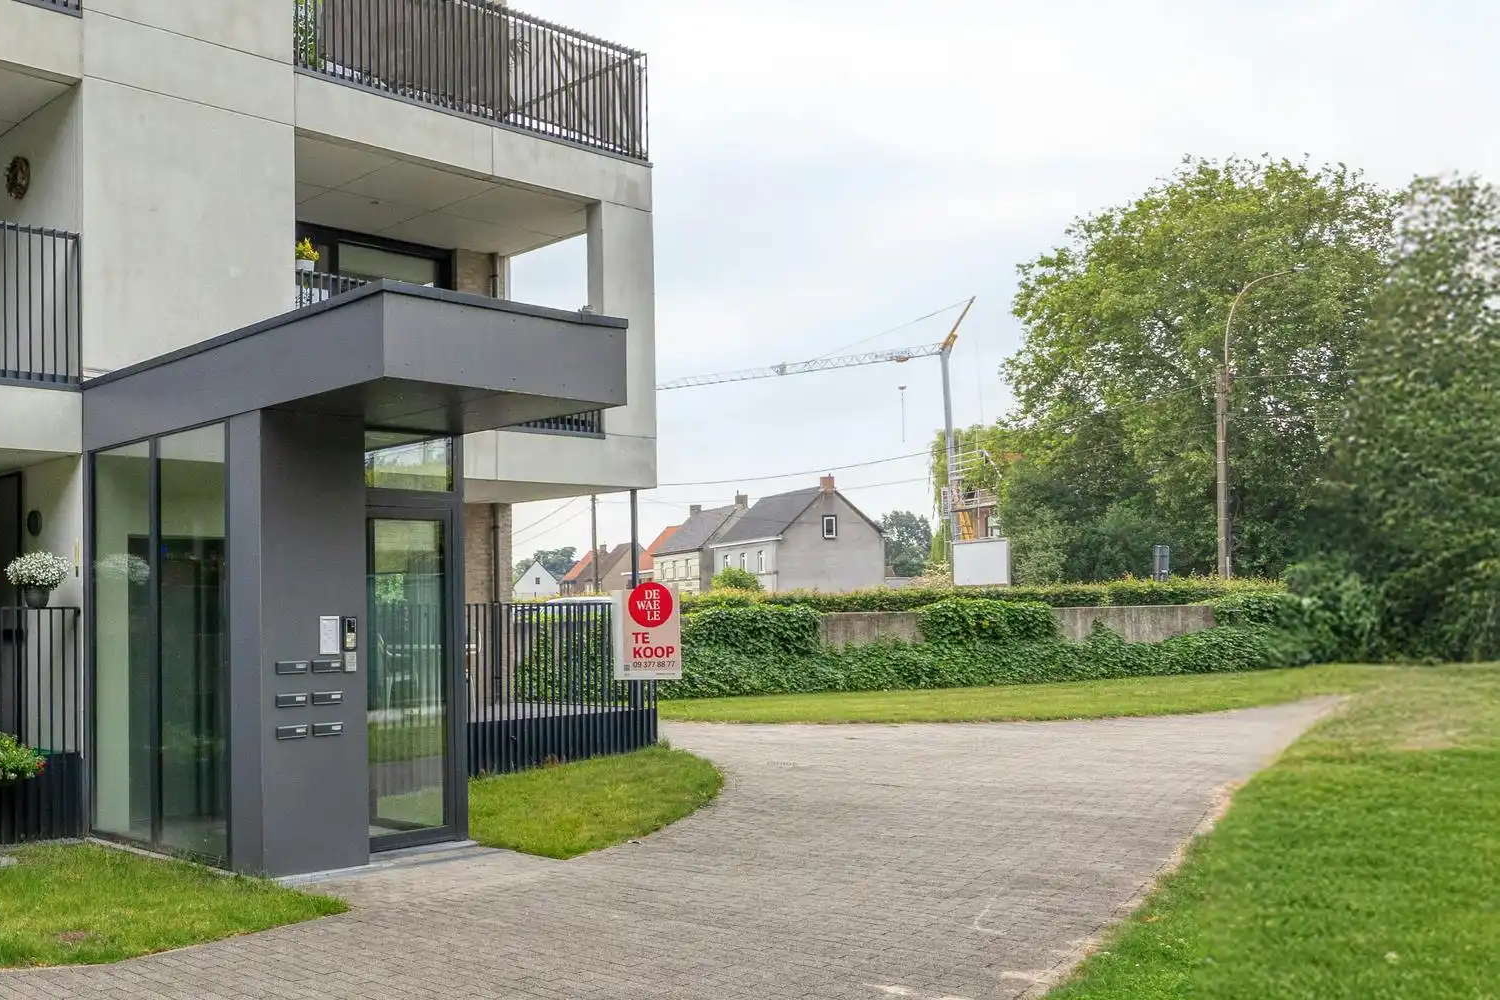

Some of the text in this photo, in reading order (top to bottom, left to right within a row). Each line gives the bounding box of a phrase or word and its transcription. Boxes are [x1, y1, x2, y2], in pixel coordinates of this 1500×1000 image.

[645, 589, 660, 600] DE
[636, 600, 660, 610] WAE
[647, 611, 660, 621] LE
[632, 632, 650, 644] TE
[633, 646, 675, 659] KOOP
[667, 660, 676, 668] 77
